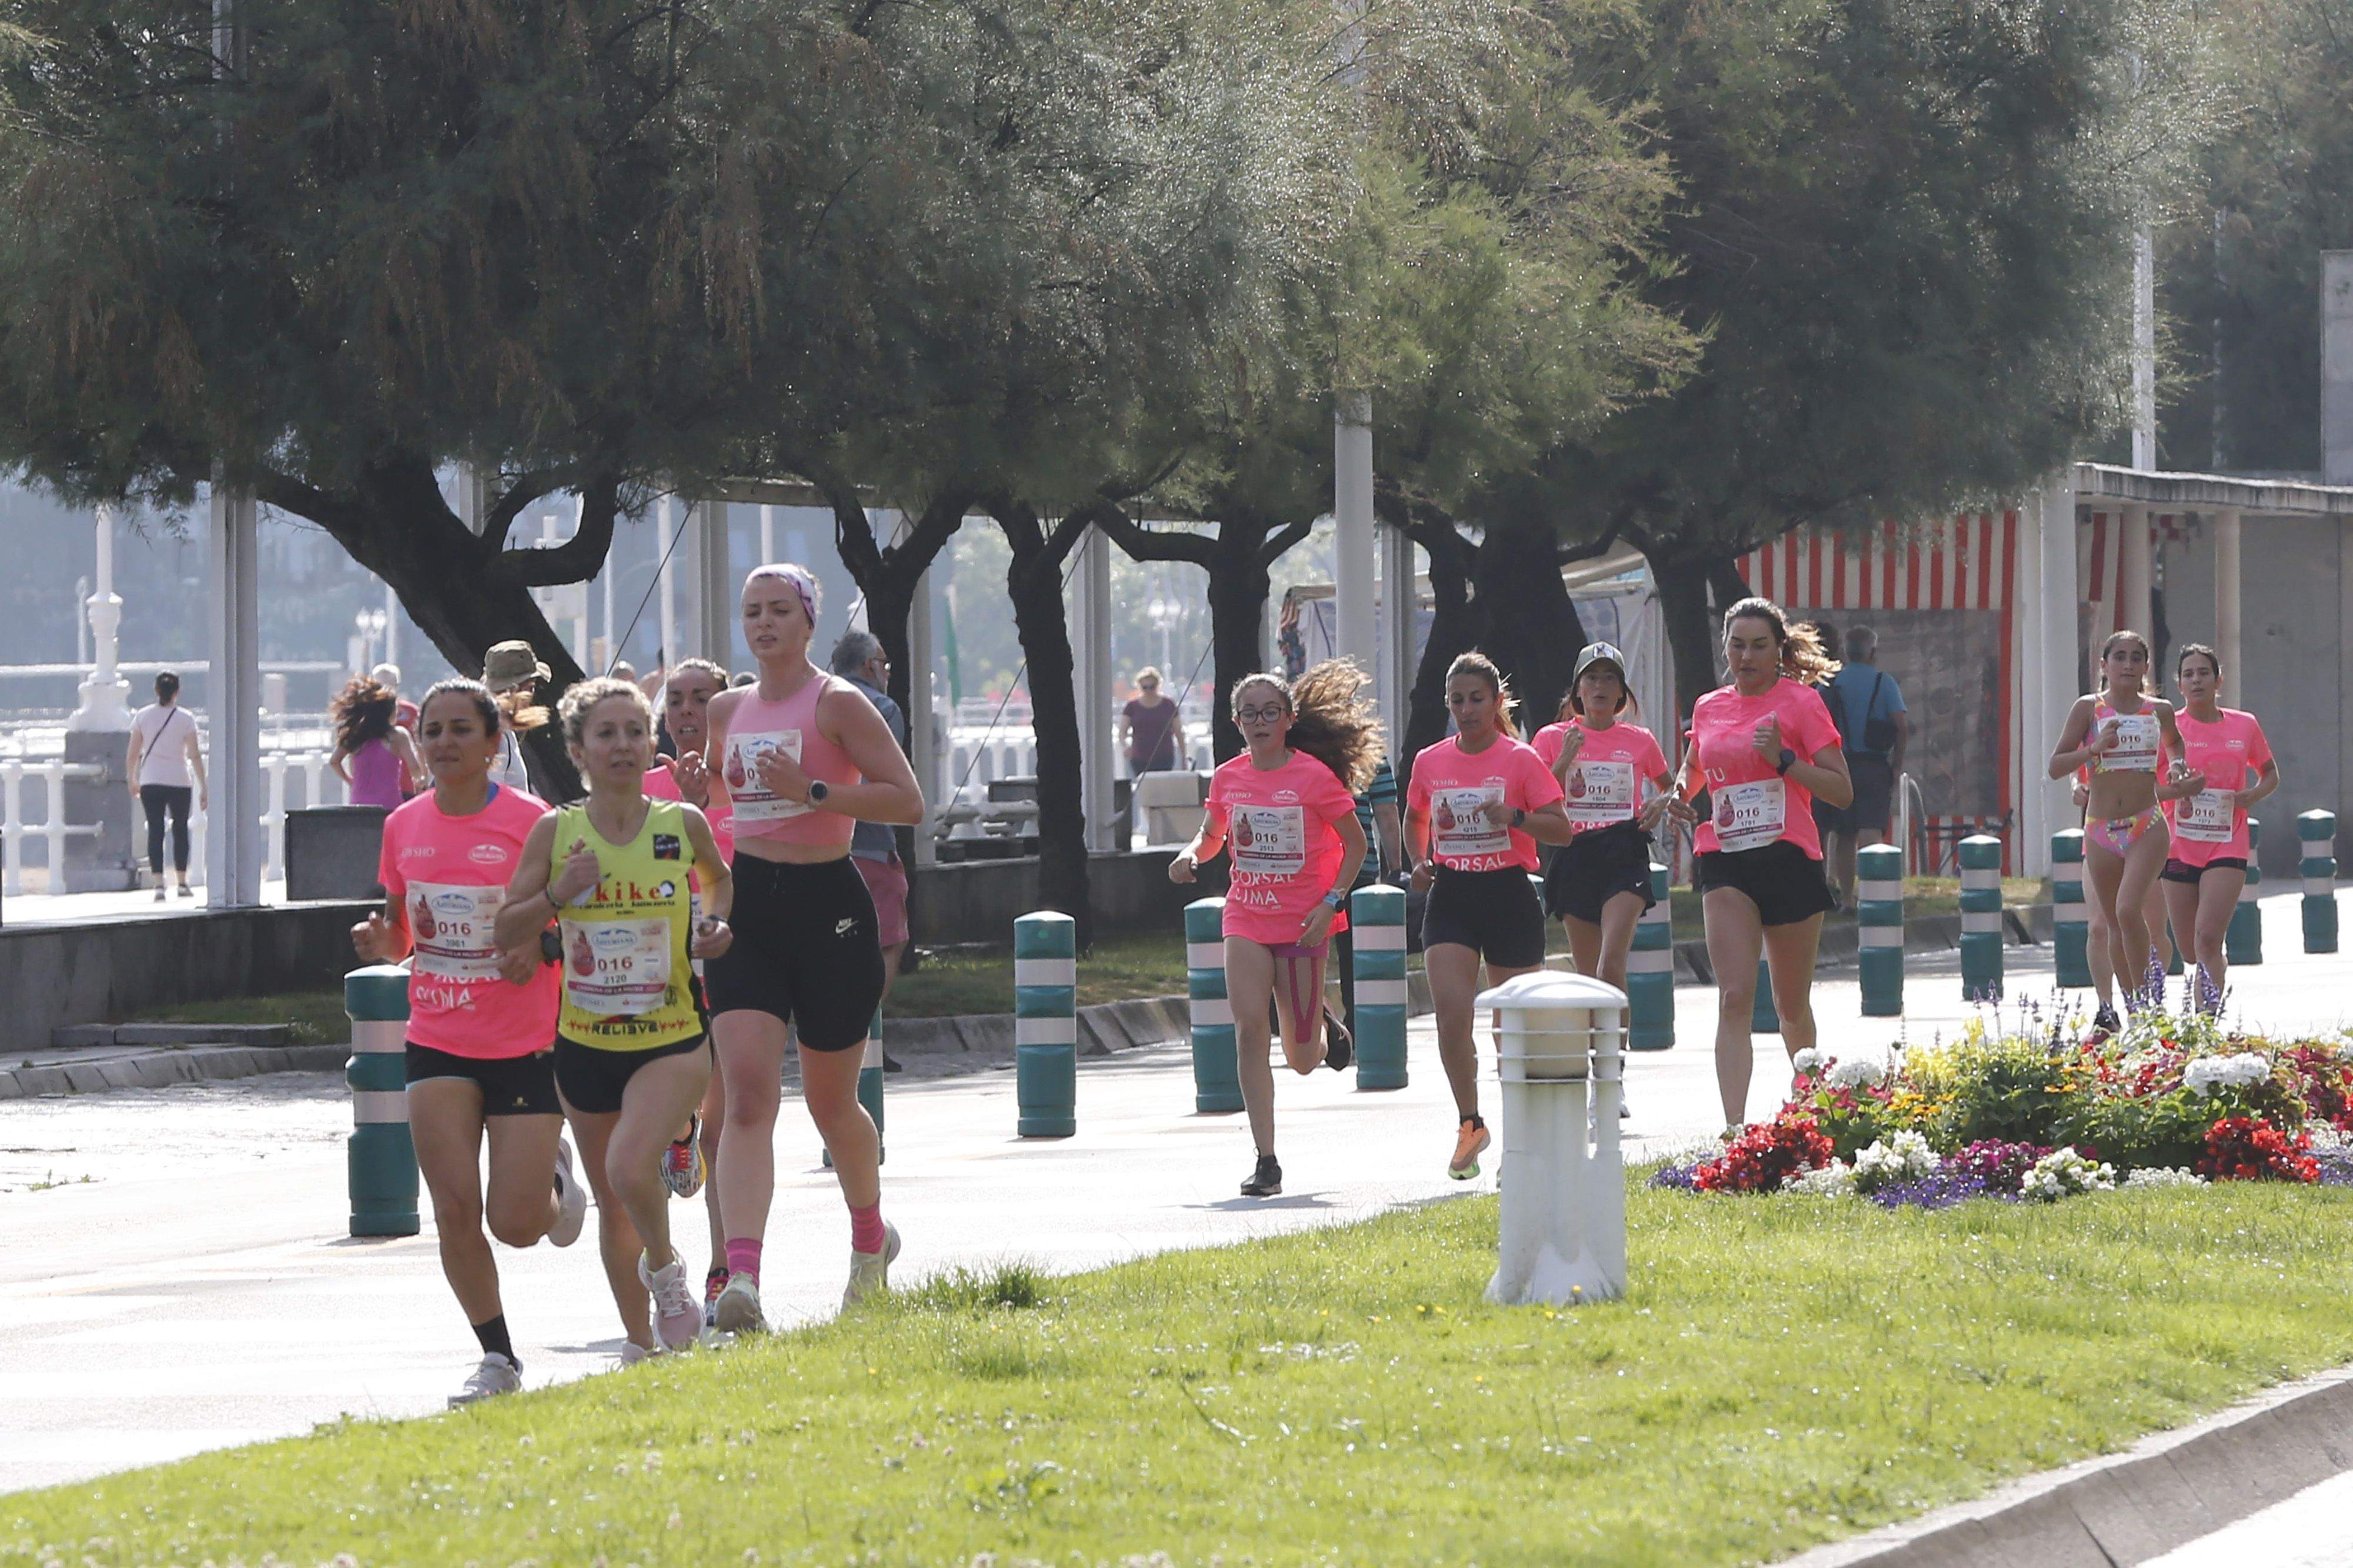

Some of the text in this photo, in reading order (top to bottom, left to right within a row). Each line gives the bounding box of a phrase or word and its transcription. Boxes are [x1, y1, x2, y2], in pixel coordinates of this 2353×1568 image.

[2121, 735, 2141, 743] 016
[1704, 767, 1725, 783] TU
[1588, 785, 1611, 794] 016
[1737, 807, 1759, 819] 016
[2195, 809, 2214, 817] 016
[1457, 814, 1481, 824] 016
[1255, 832, 1278, 843] 016
[1445, 853, 1506, 872] ORSAL
[438, 921, 471, 935] 016
[598, 956, 633, 972] 016
[604, 974, 627, 984] 2120
